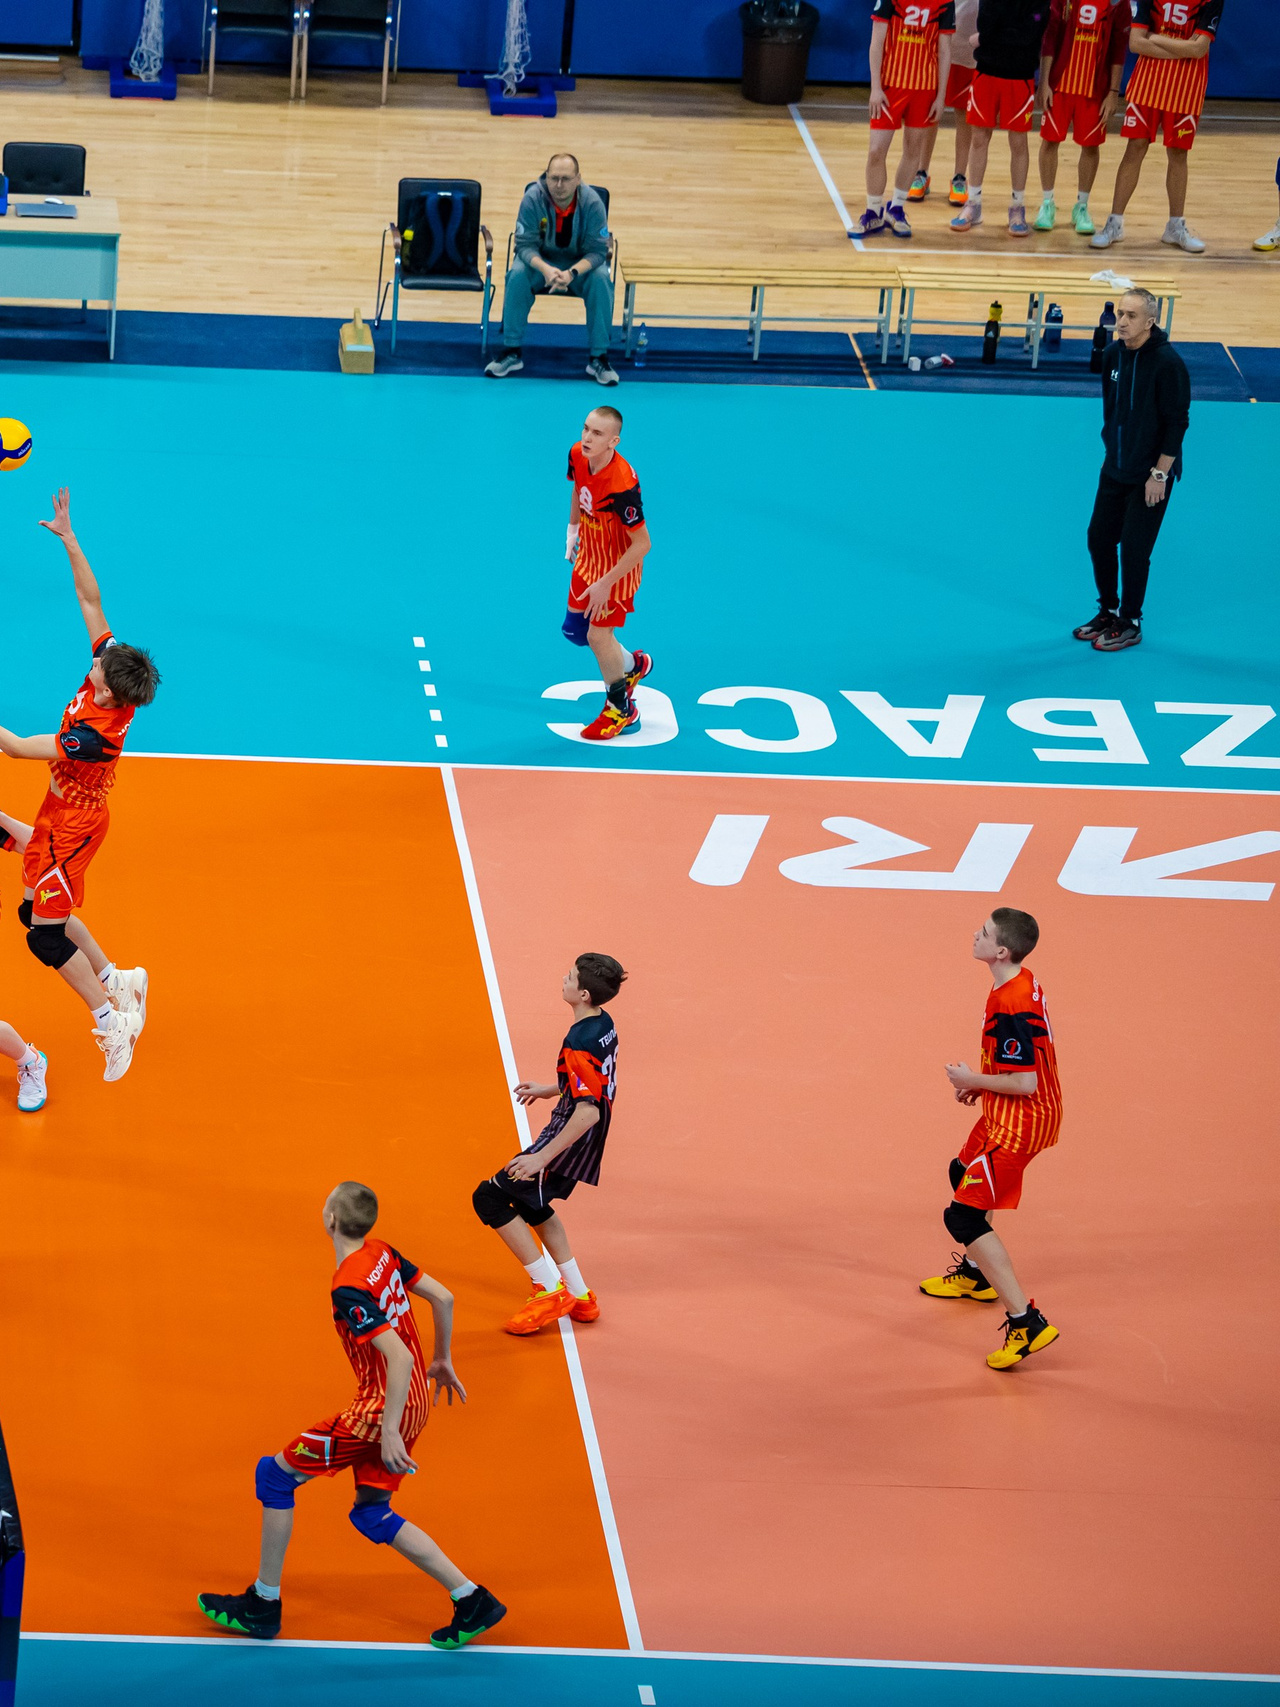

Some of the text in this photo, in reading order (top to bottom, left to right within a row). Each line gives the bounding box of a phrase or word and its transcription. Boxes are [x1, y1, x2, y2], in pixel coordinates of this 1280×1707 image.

[904, 5, 930, 27] 21
[1079, 5, 1097, 25] 9
[1162, 2, 1189, 26] 15
[1123, 115, 1137, 128] 15
[379, 1268, 410, 1328] 23
